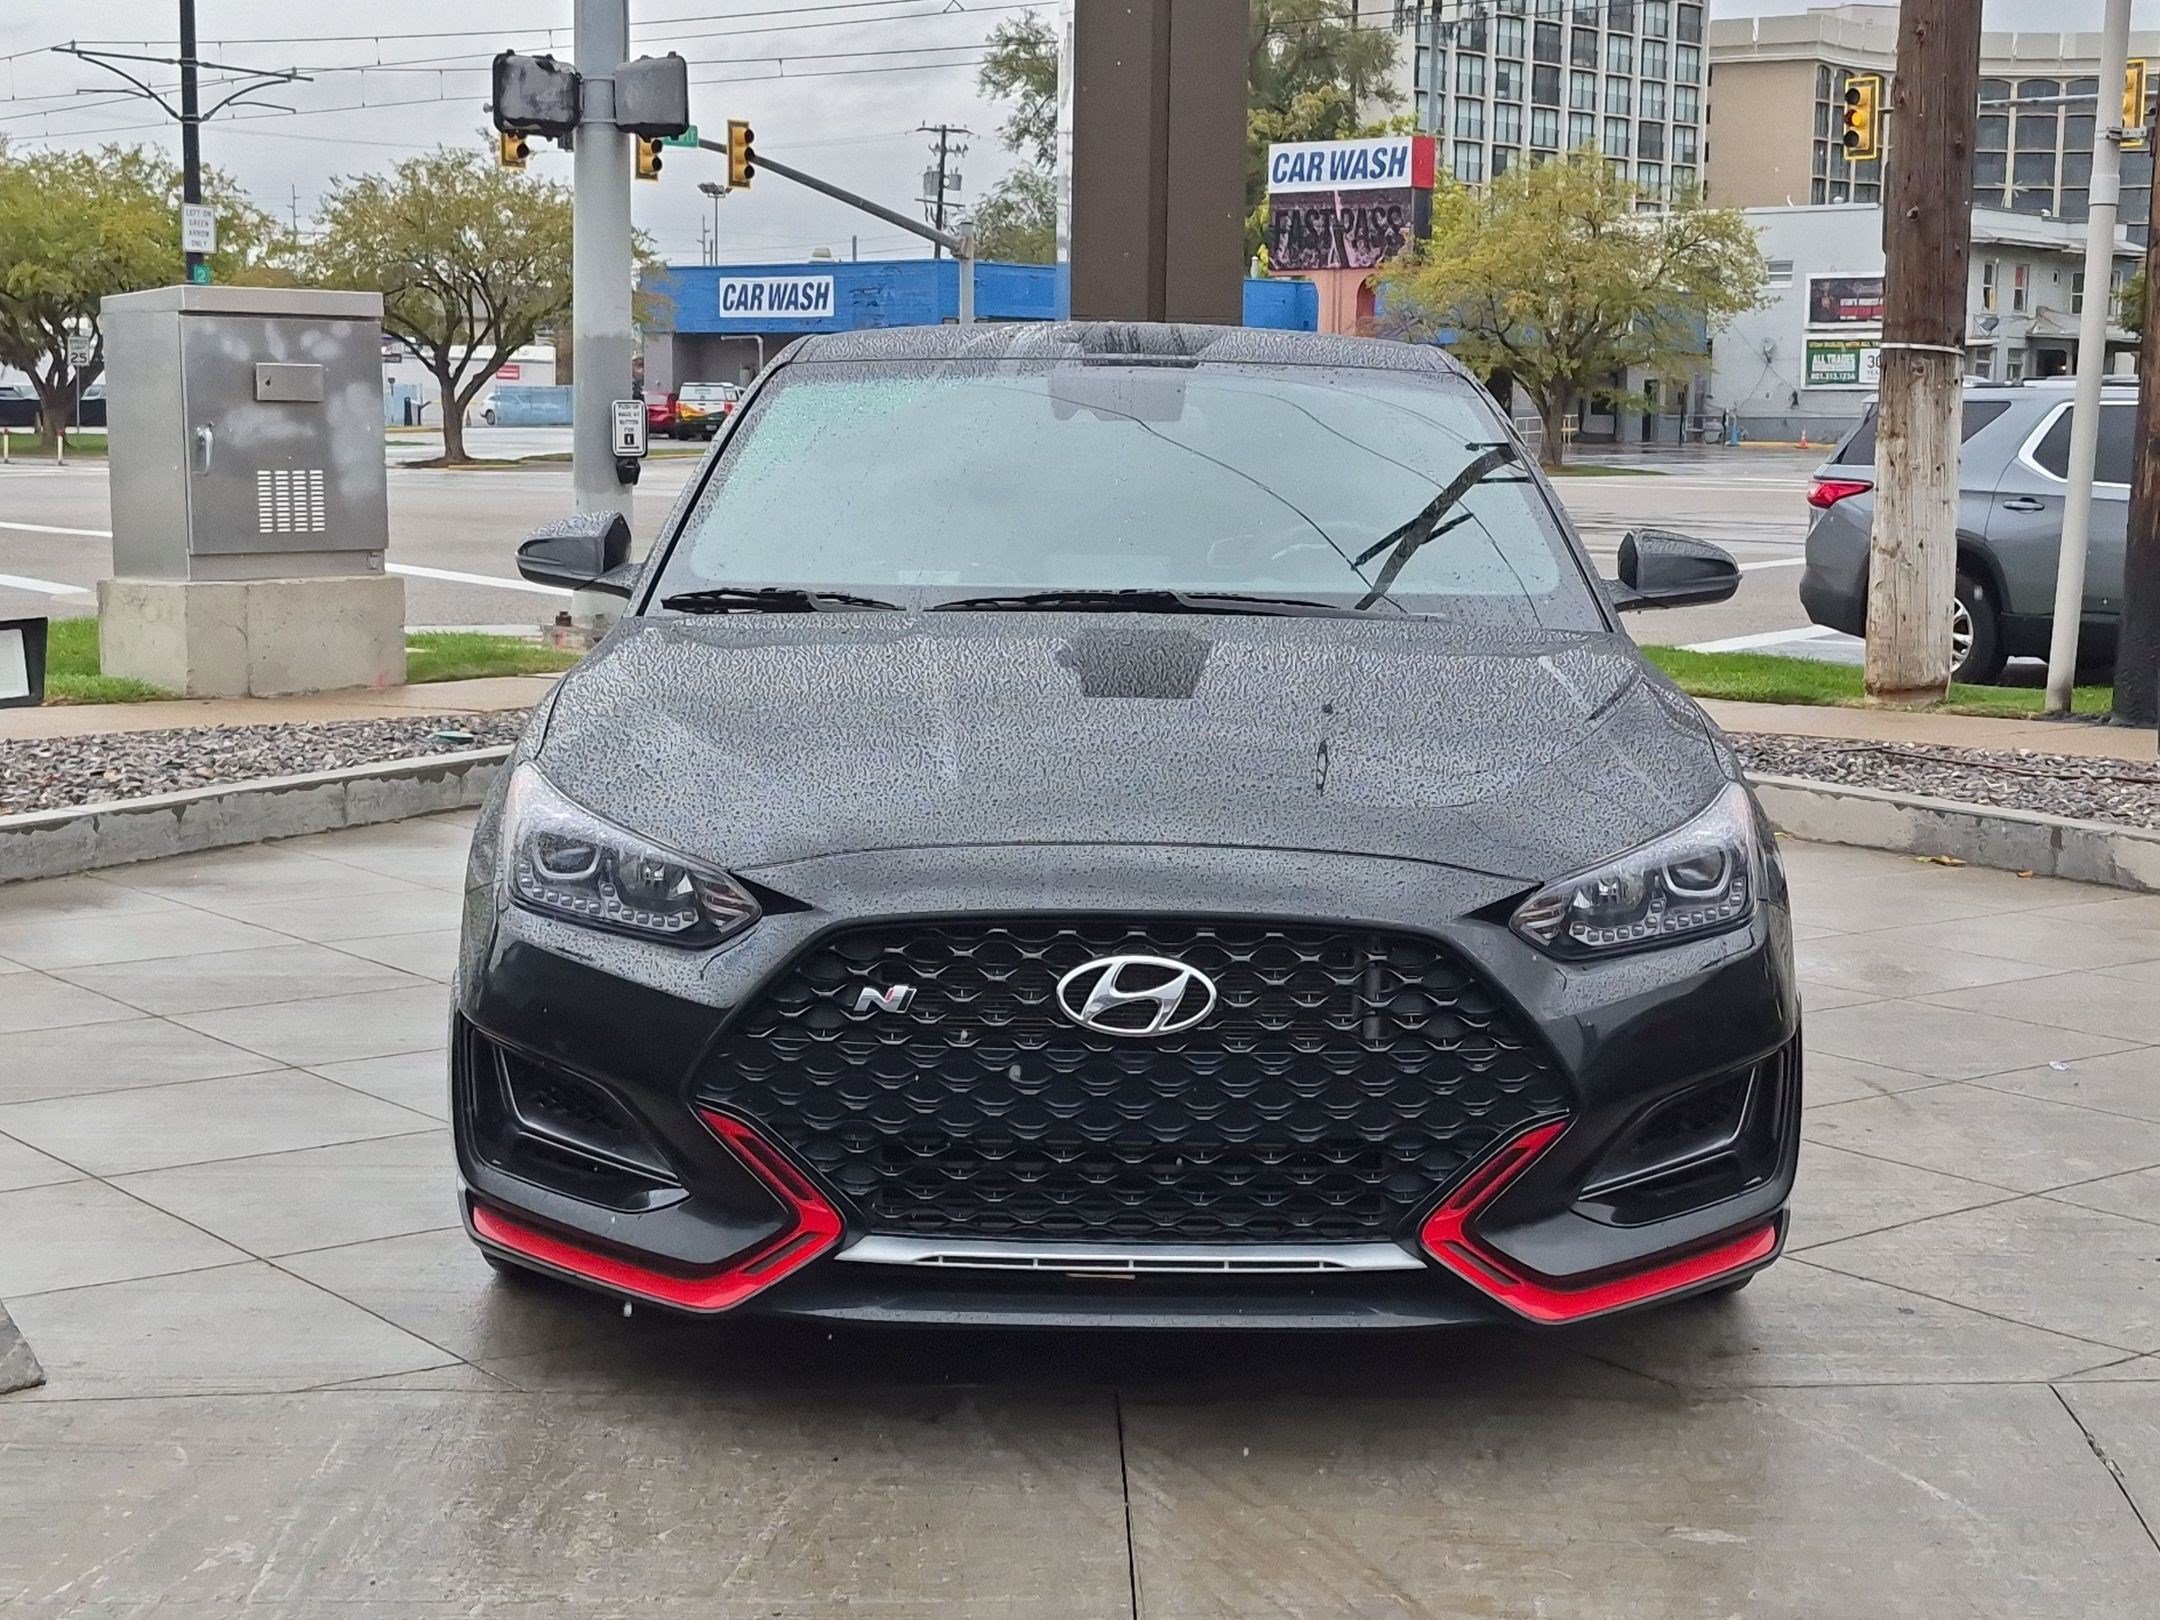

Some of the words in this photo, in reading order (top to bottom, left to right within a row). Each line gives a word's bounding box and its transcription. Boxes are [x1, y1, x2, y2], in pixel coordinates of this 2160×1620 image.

[1272, 151, 1325, 183] CAR
[1329, 146, 1408, 180] WASH
[186, 208, 200, 217] LEFT
[189, 219, 209, 227] GREEN
[723, 283, 765, 311] CAR
[768, 282, 830, 311] WASH
[71, 352, 87, 363] 25
[1814, 354, 1826, 364] ALL
